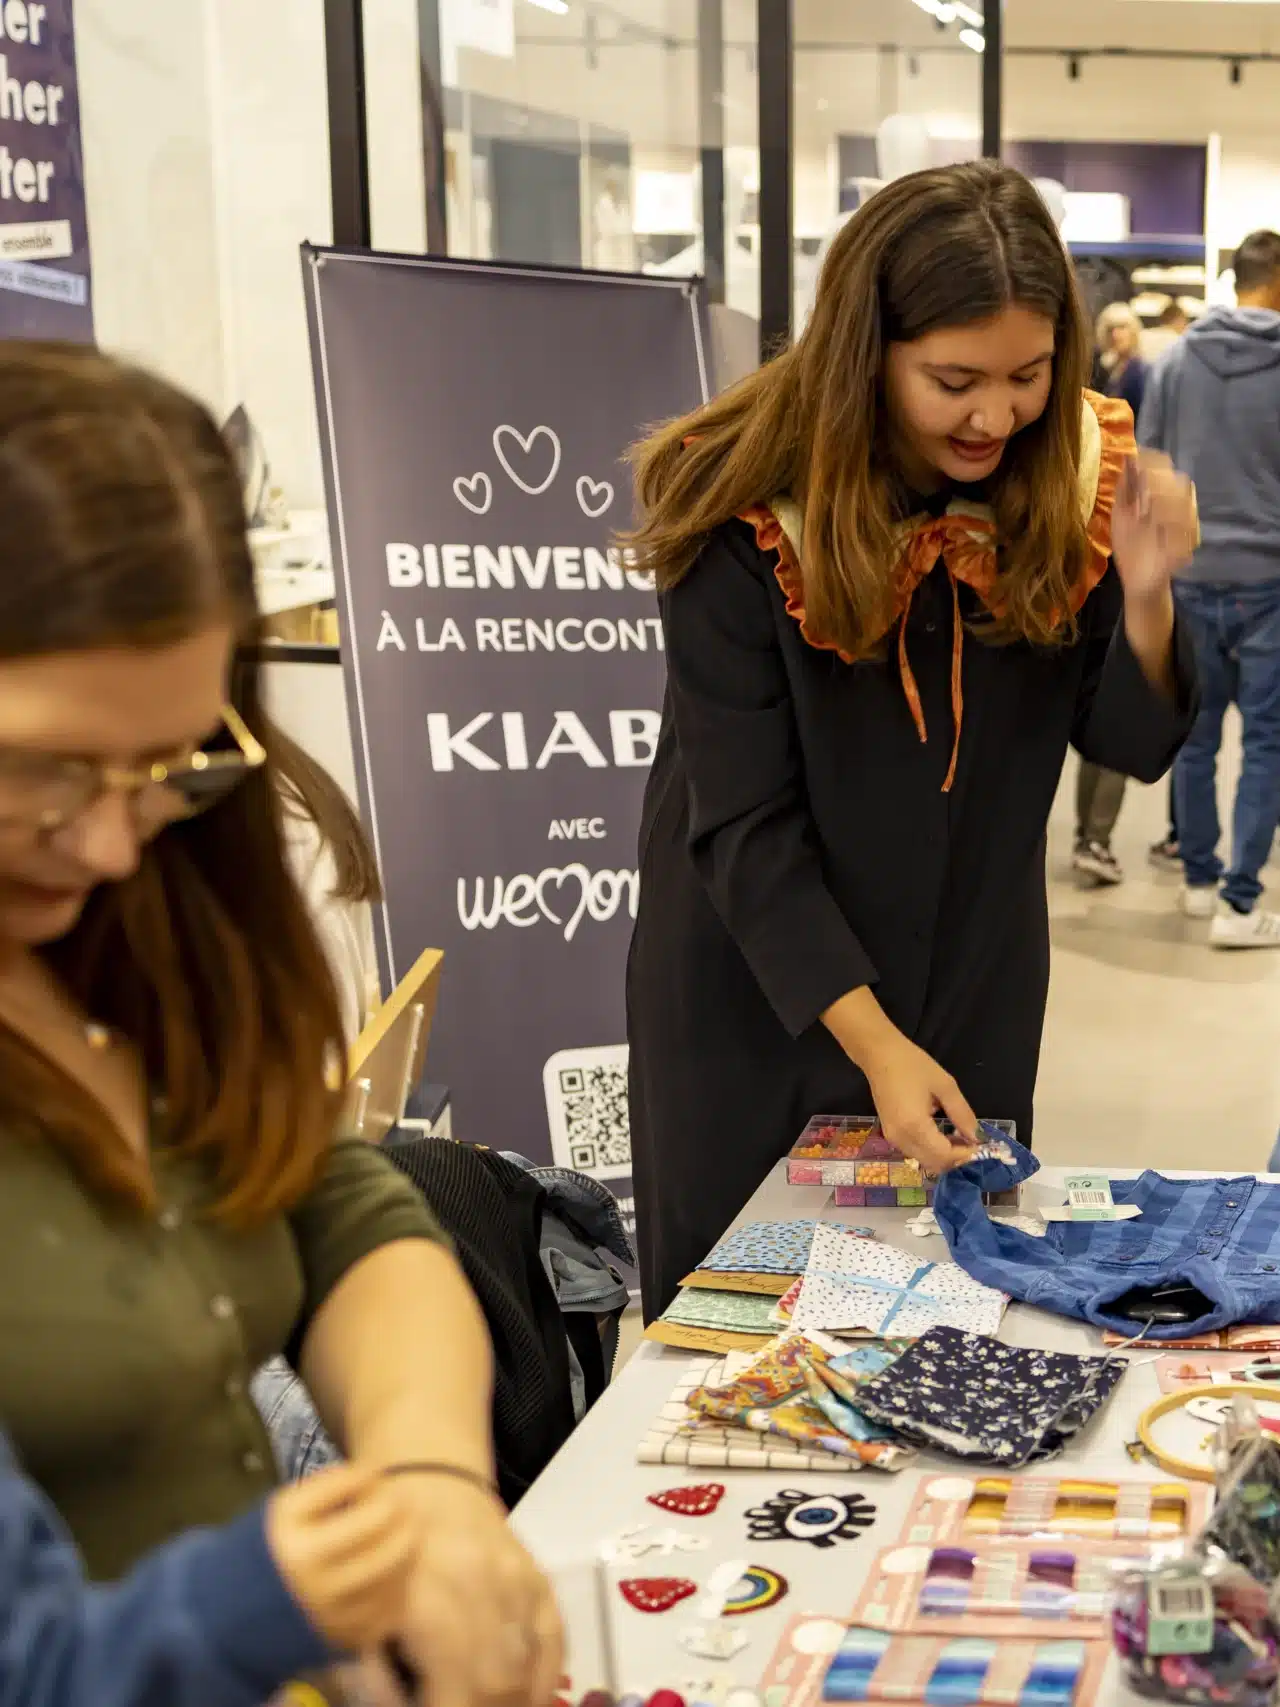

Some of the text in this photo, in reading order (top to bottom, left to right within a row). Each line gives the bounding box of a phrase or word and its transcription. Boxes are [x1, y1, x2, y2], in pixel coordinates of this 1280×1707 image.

[0, 0, 46, 46] er
[376, 610, 406, 651] À
[415, 617, 466, 651] LA
[427, 710, 662, 772] KIAB
[548, 817, 607, 840] AVEC
